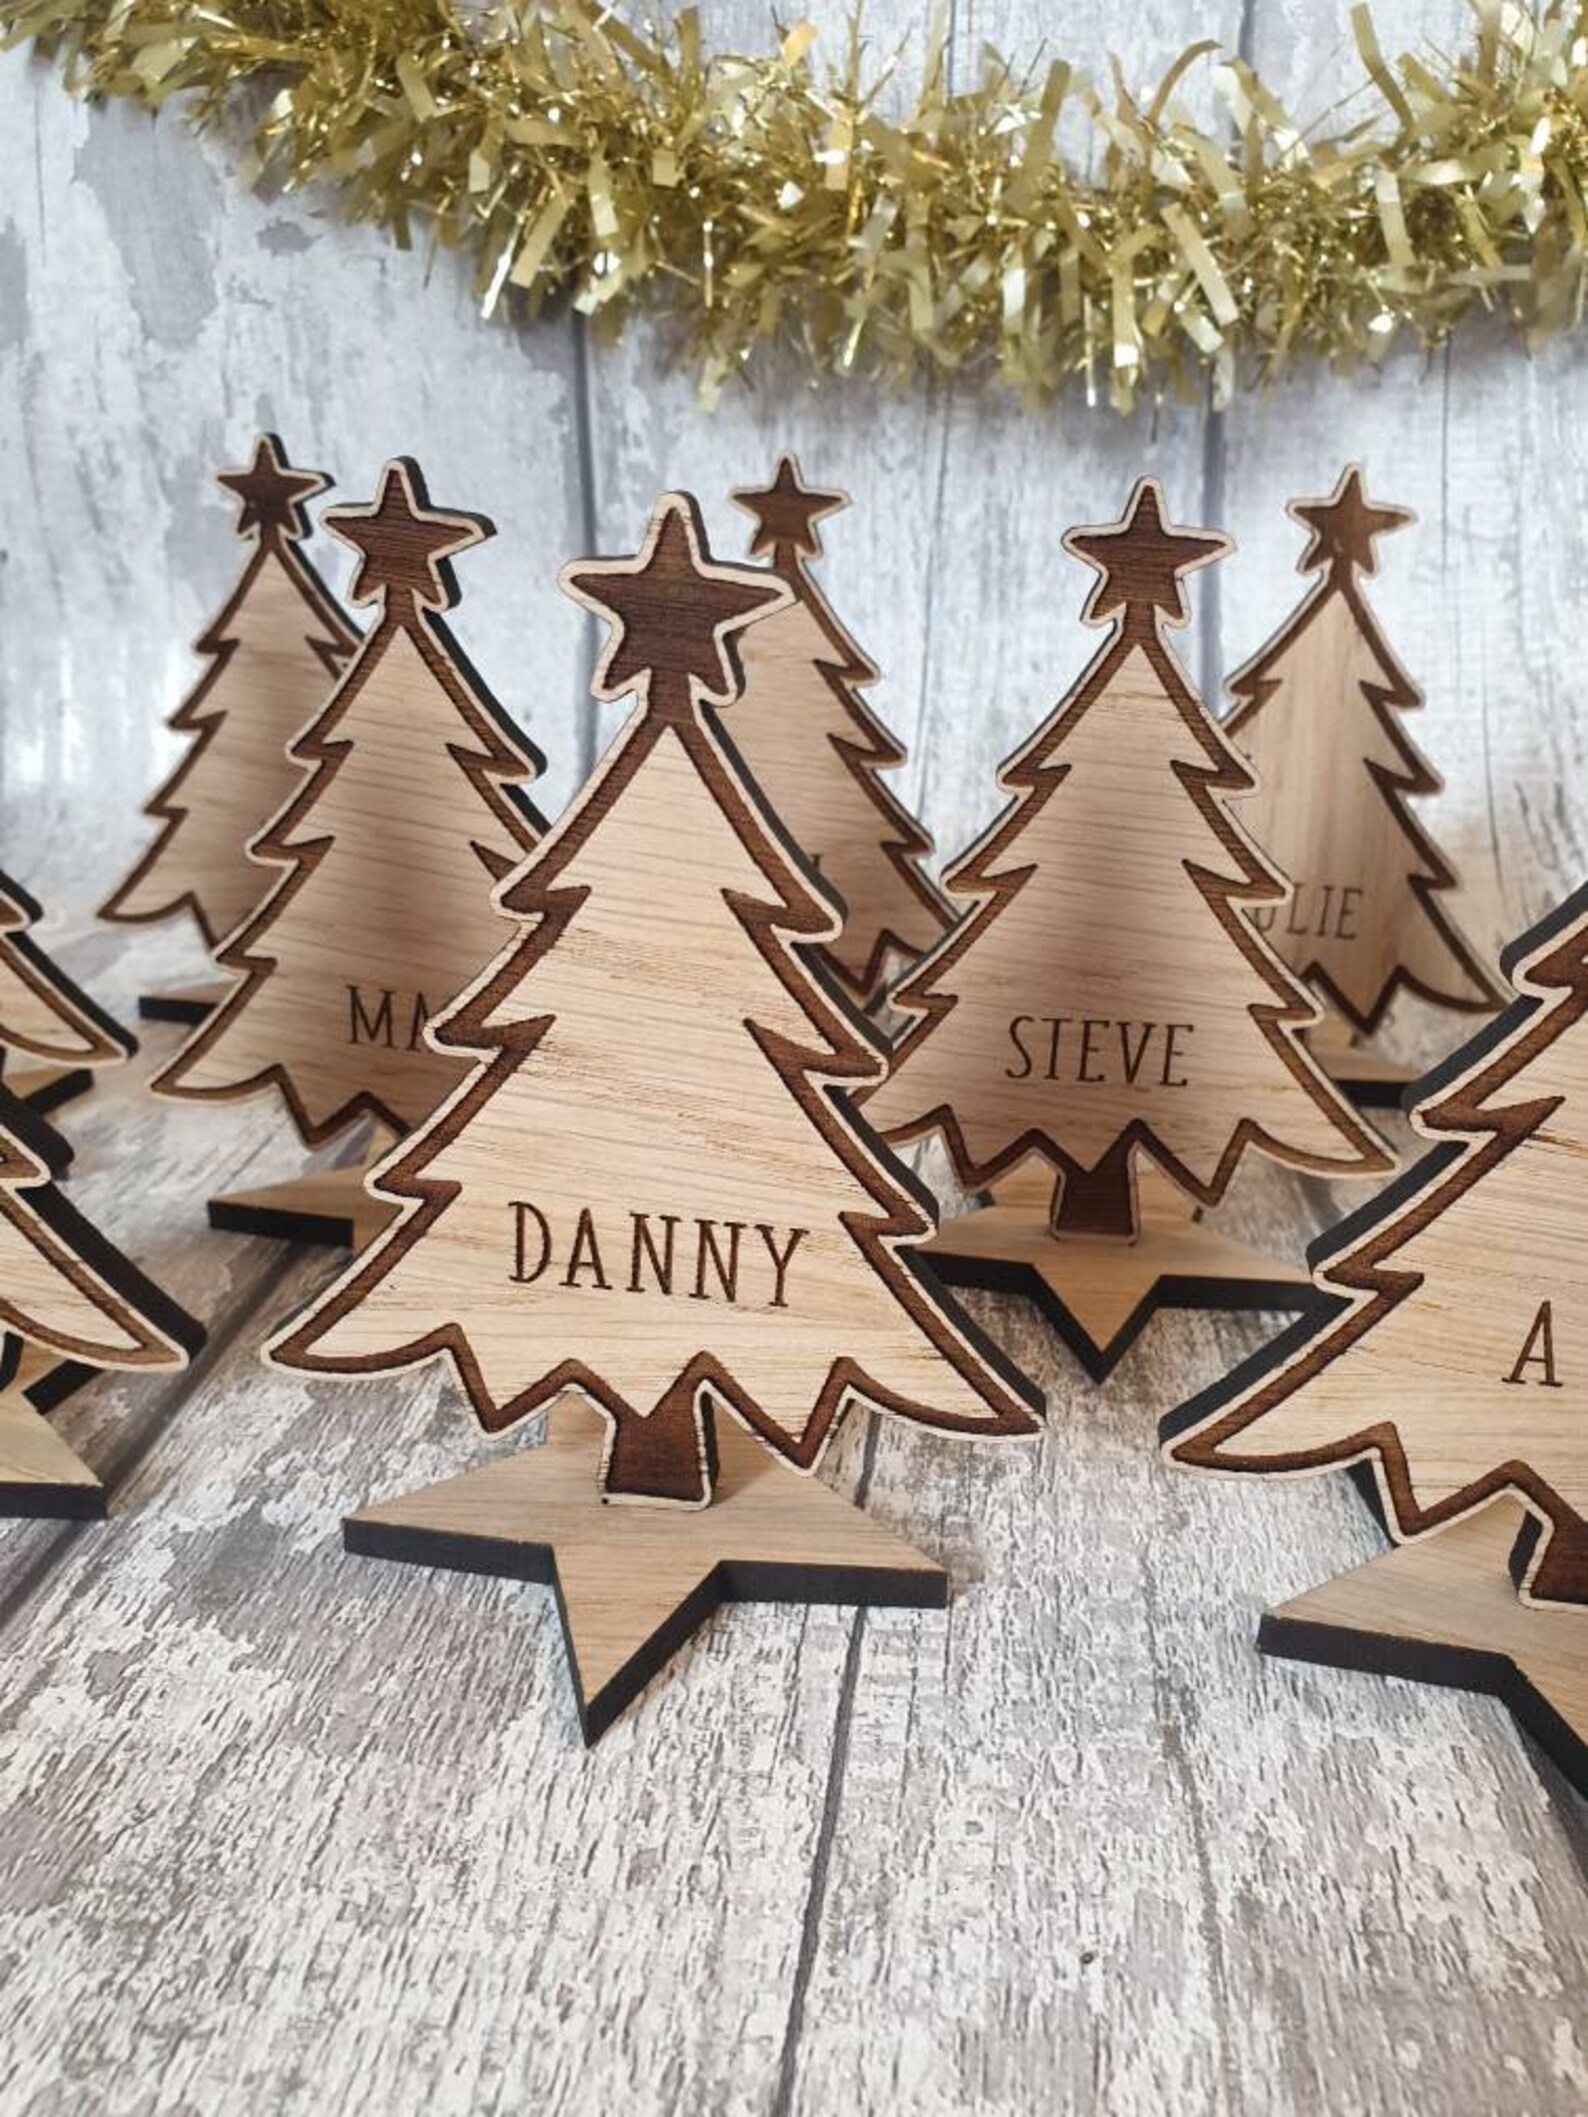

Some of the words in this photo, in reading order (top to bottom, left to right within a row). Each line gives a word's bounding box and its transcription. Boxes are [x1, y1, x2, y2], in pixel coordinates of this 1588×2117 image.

[1005, 1014, 1195, 1087] STEVE
[507, 1200, 810, 1307] DANNY
[1500, 1299, 1563, 1388] A
